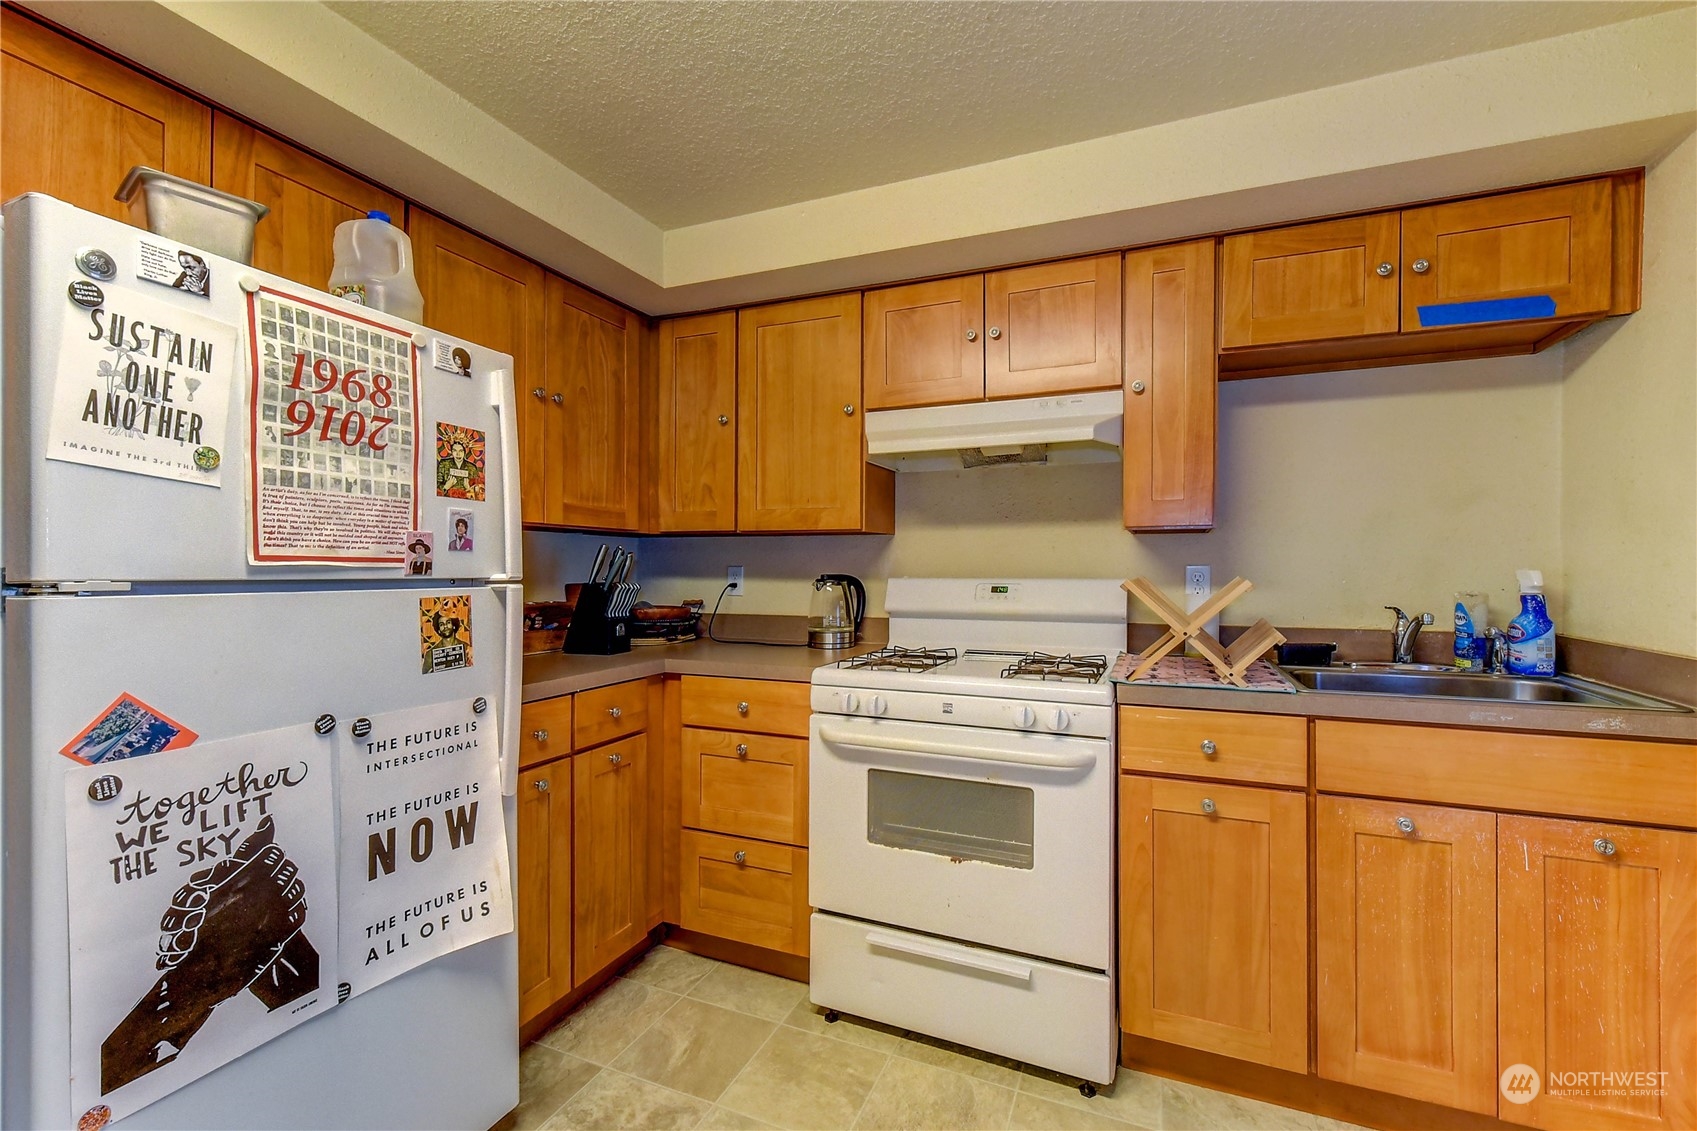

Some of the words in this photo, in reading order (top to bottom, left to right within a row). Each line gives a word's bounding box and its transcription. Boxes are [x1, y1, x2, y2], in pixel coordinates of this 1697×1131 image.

[74, 282, 98, 291] Black
[74, 294, 102, 302] Matter
[88, 308, 214, 374] SUSTAIN
[125, 361, 176, 404] ONE
[285, 353, 393, 409] 1968
[82, 388, 202, 445] ANOTHER
[62, 441, 122, 458] IMAGINE
[127, 452, 148, 462] THE
[153, 458, 172, 466] 3rd
[366, 738, 398, 754] THE
[405, 724, 460, 746] FUTURE
[466, 721, 478, 734] IS
[366, 740, 478, 774] INTERSECTIONAL
[116, 761, 308, 825] together
[366, 806, 398, 826] THE
[405, 788, 460, 814] FUTURE
[466, 782, 480, 795] IS
[116, 820, 170, 853] WE
[200, 792, 273, 832] LIFT
[368, 800, 479, 882] NOW
[109, 846, 158, 884] THE
[178, 827, 241, 868] SKY
[365, 932, 410, 966] ALL
[420, 914, 450, 938] OF
[461, 901, 491, 922] US
[366, 916, 396, 939] THE
[404, 888, 465, 922] FUTURE
[472, 880, 488, 896] IS
